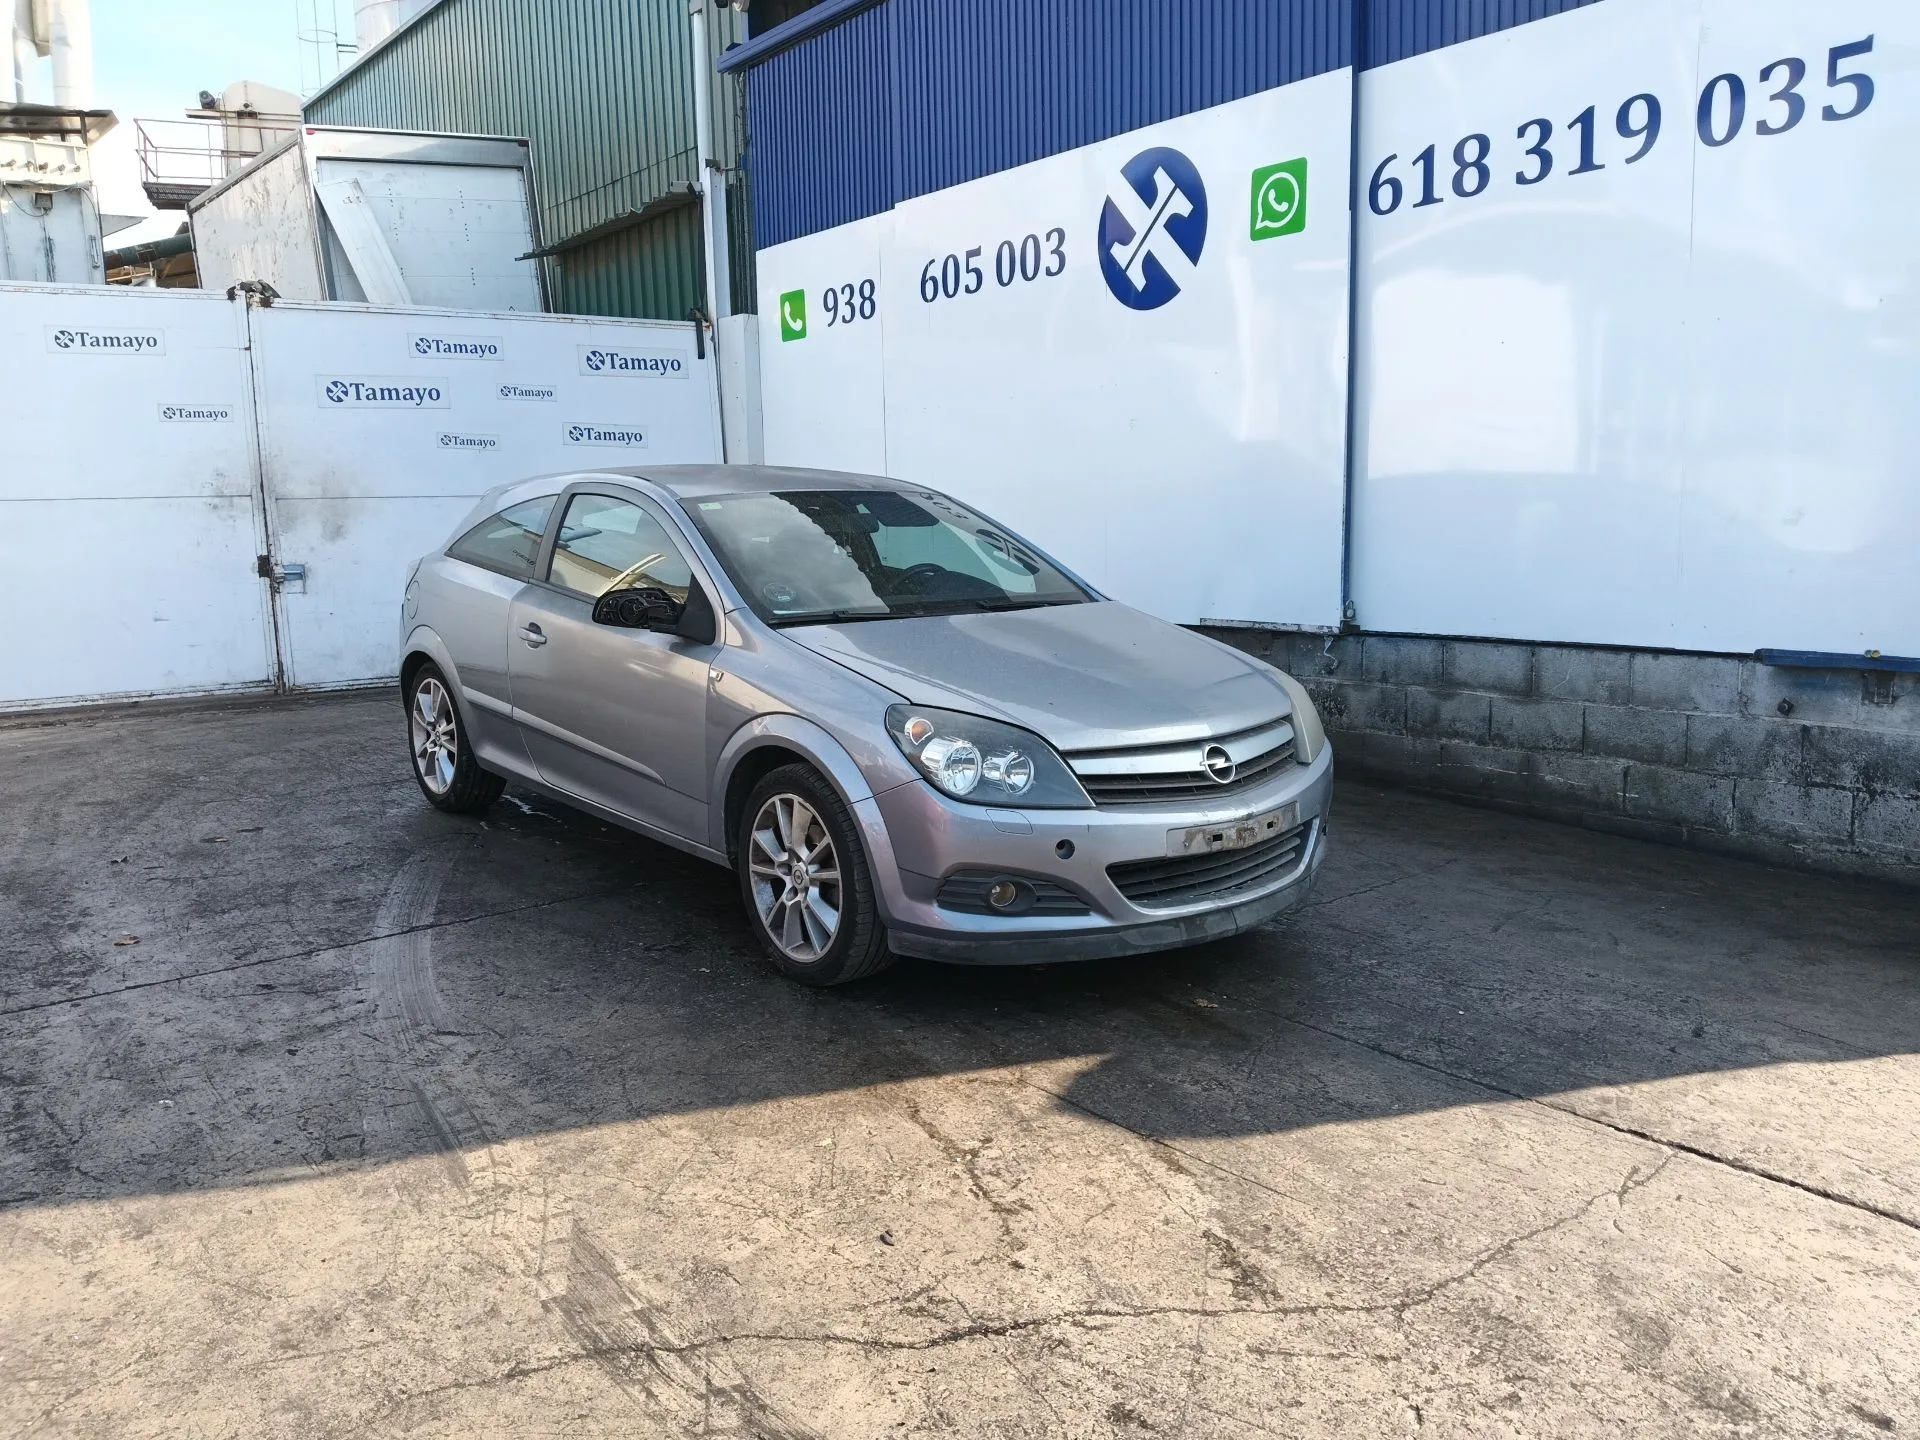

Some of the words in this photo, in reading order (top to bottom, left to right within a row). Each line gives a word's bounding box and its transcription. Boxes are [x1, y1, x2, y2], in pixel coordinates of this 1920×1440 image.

[1368, 133, 1491, 216] 618
[1515, 93, 1662, 186] 319
[1696, 33, 1876, 148] 035
[822, 278, 876, 328] 938
[920, 245, 984, 304] 605
[995, 227, 1067, 288] 003
[75, 331, 158, 352] Tamayo
[431, 339, 498, 359] Tamayo
[605, 352, 682, 376] Tamayo
[349, 382, 441, 407] Tamayo
[510, 386, 554, 400] Tamayo
[176, 408, 228, 422] Tamayo
[451, 435, 496, 449] Tamayo
[583, 427, 643, 446] Tamayo
